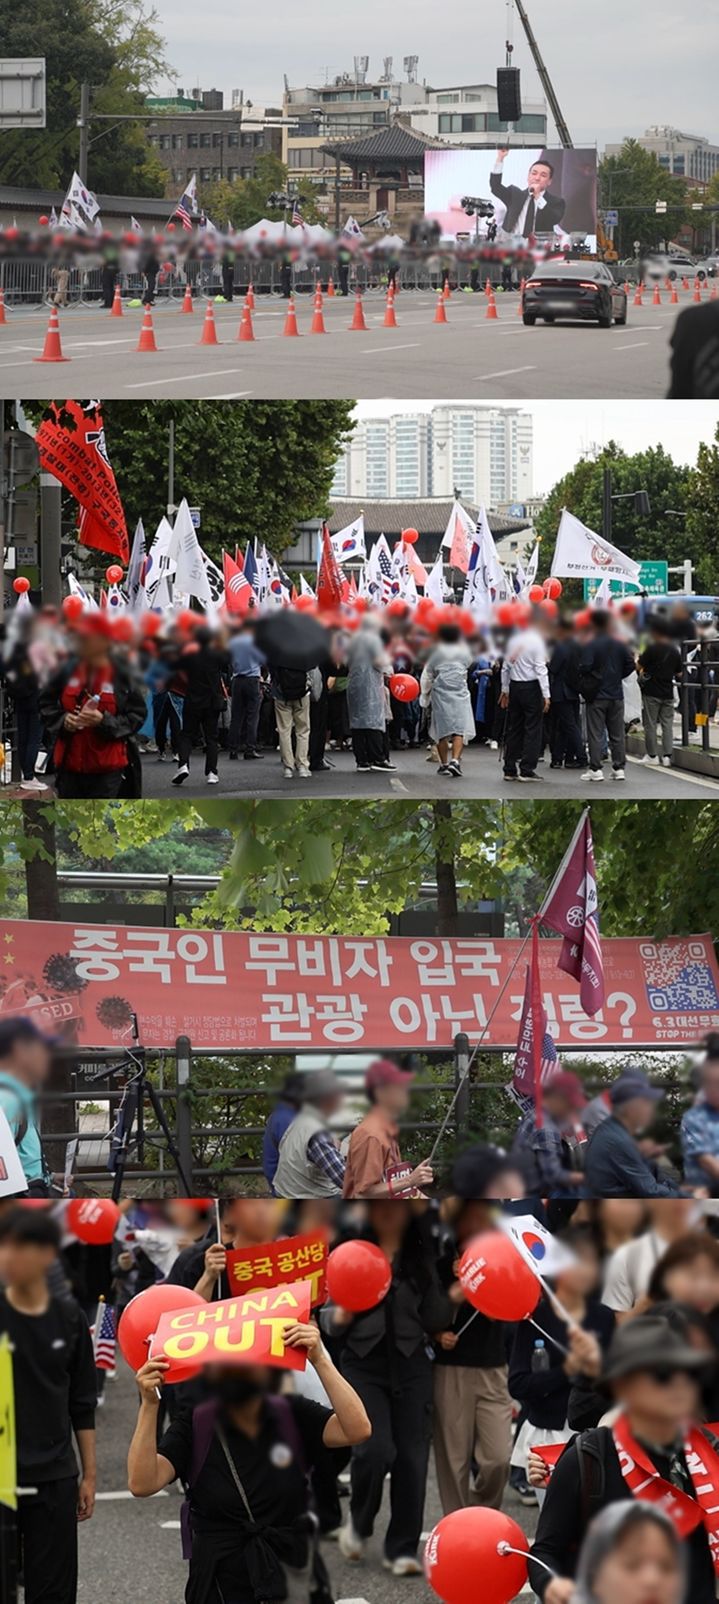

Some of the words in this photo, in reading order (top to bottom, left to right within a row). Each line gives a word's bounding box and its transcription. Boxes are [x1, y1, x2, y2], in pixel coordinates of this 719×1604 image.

[56, 431, 97, 470] combat
[97, 471, 121, 504] Polic
[696, 611, 713, 621] 262
[70, 929, 227, 984] 중국인
[245, 937, 393, 986] 무비자
[410, 940, 501, 986] 입국
[261, 993, 368, 1042] 관광
[390, 993, 490, 1041] 아닌
[656, 1030, 679, 1039] STOP
[233, 1257, 273, 1282] 중국
[277, 1241, 325, 1273] 공산당
[170, 1290, 298, 1329] CHINA
[163, 1317, 298, 1359] OUT
